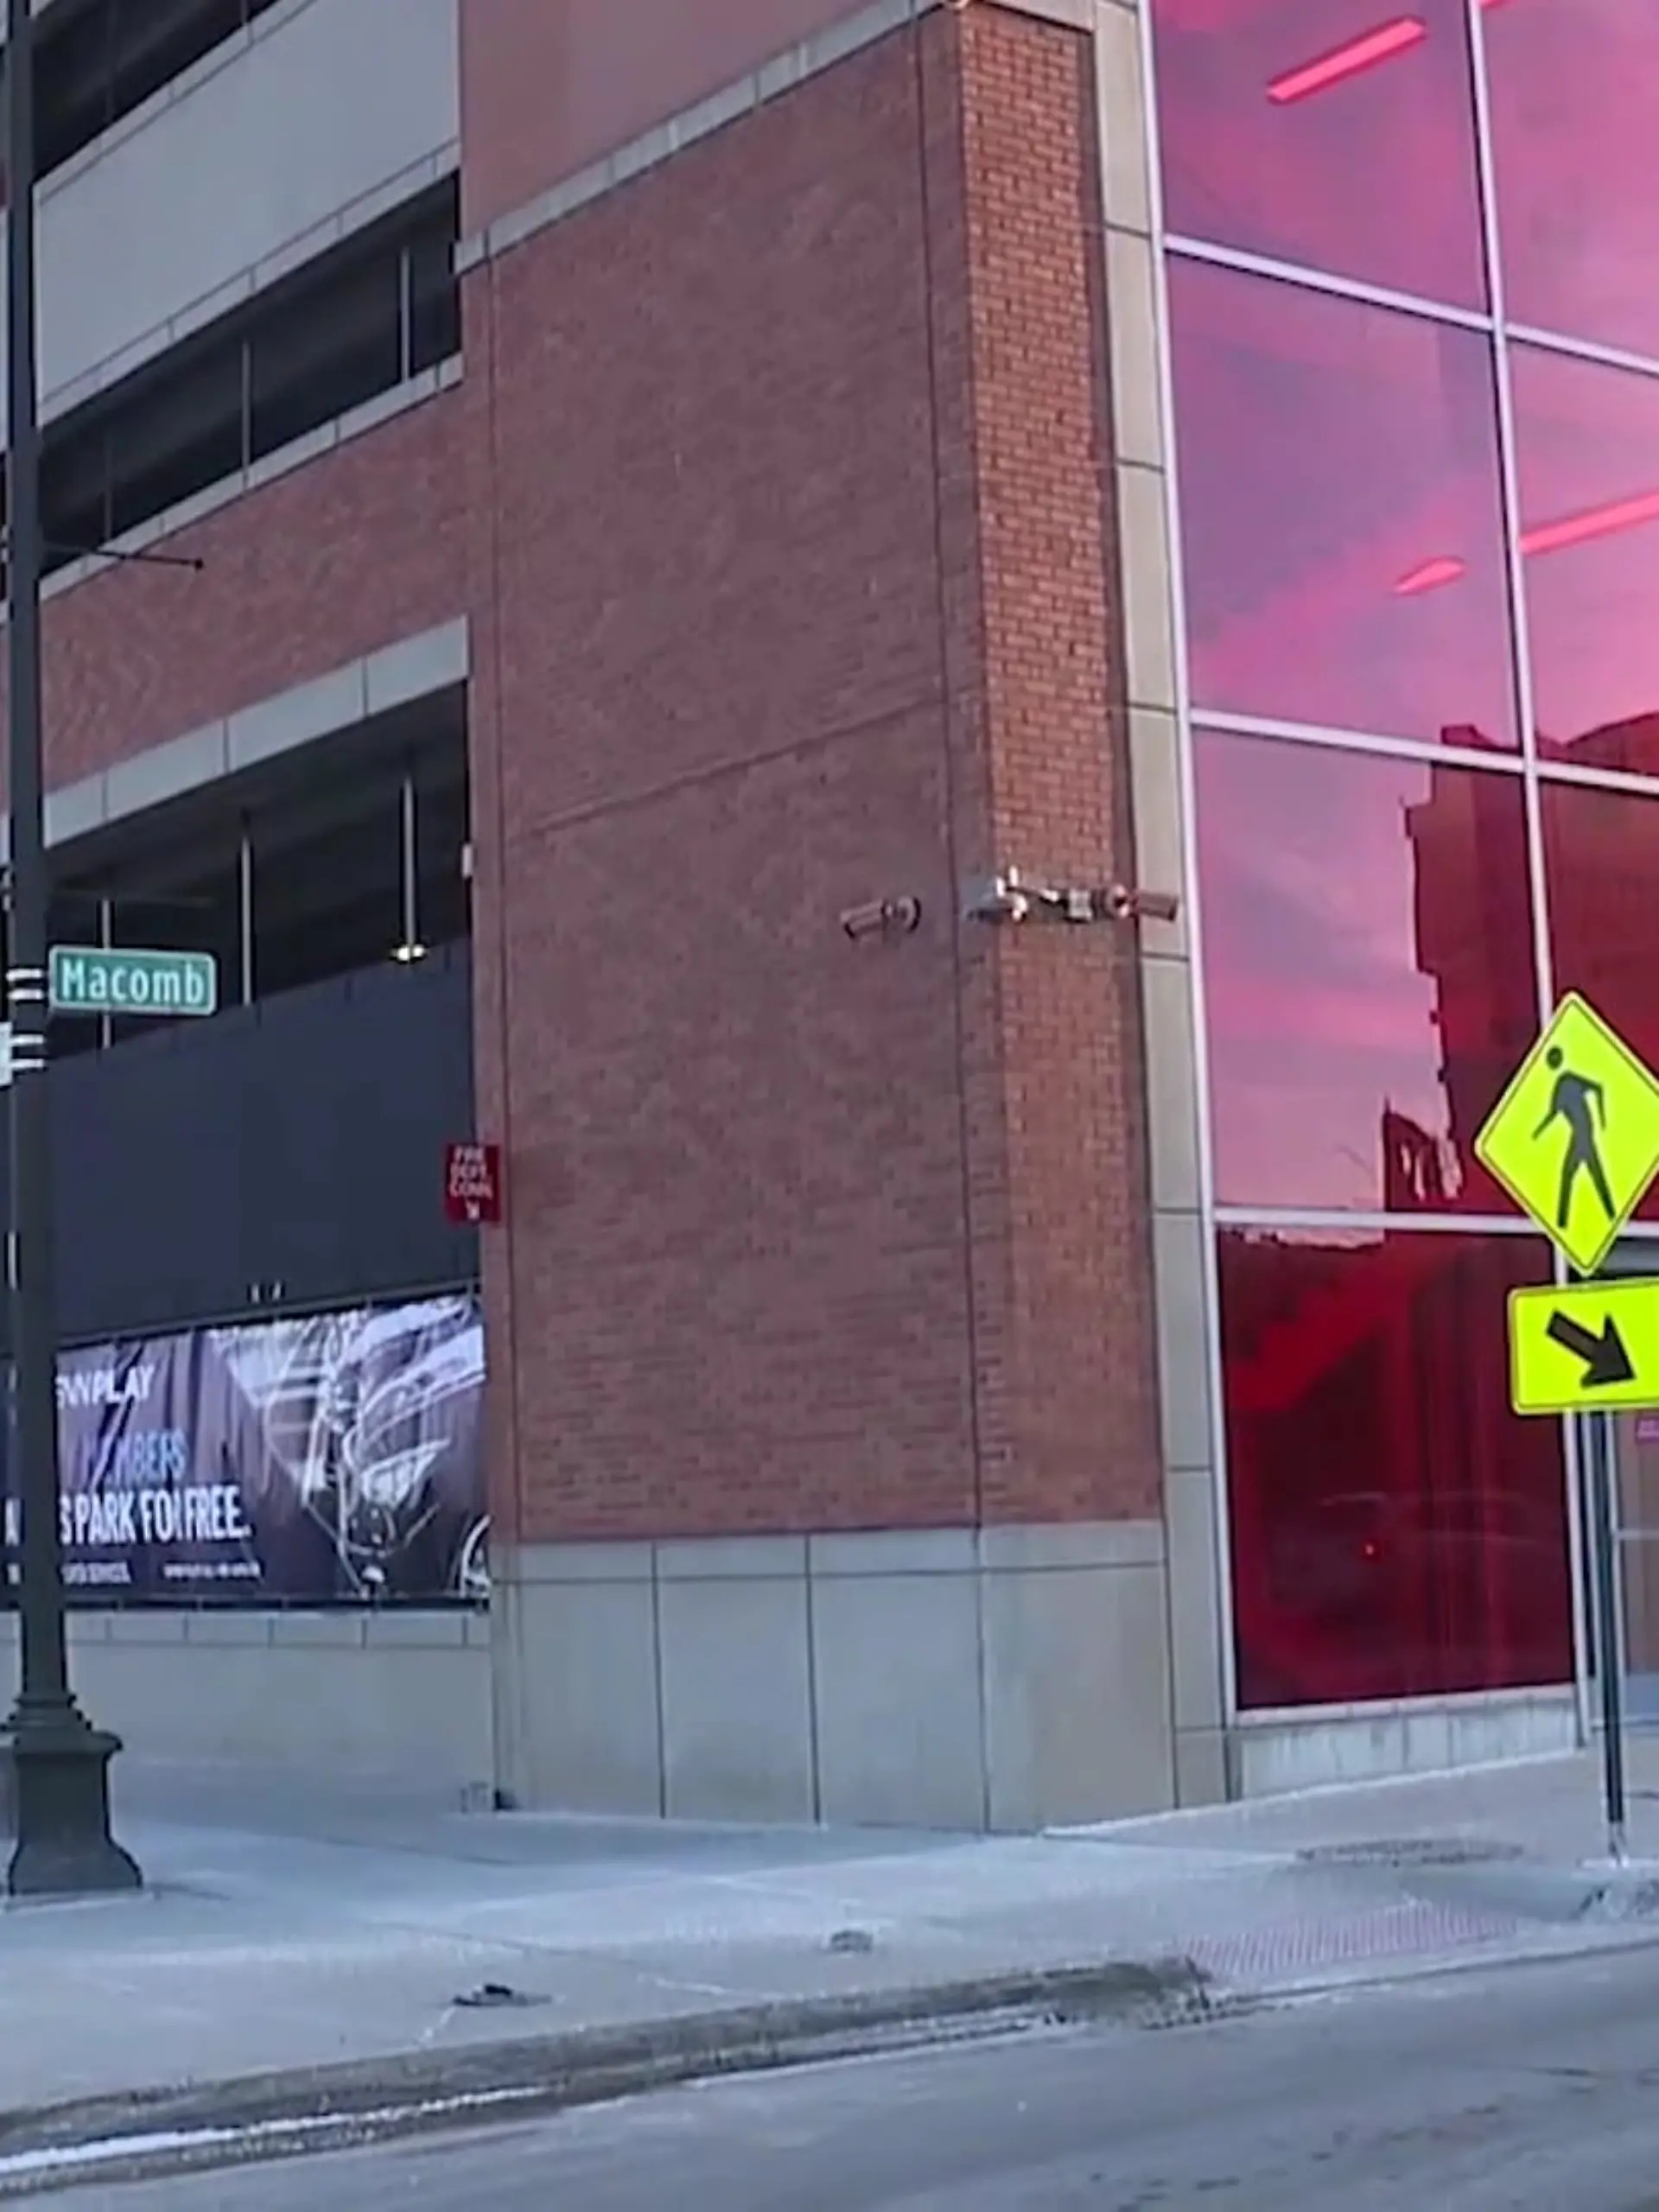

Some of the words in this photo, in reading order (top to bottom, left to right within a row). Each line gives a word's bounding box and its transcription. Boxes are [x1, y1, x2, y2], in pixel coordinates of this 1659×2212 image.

[61, 957, 205, 1004] Macomb
[92, 1364, 156, 1404] PLAY
[74, 1491, 136, 1543] PARK
